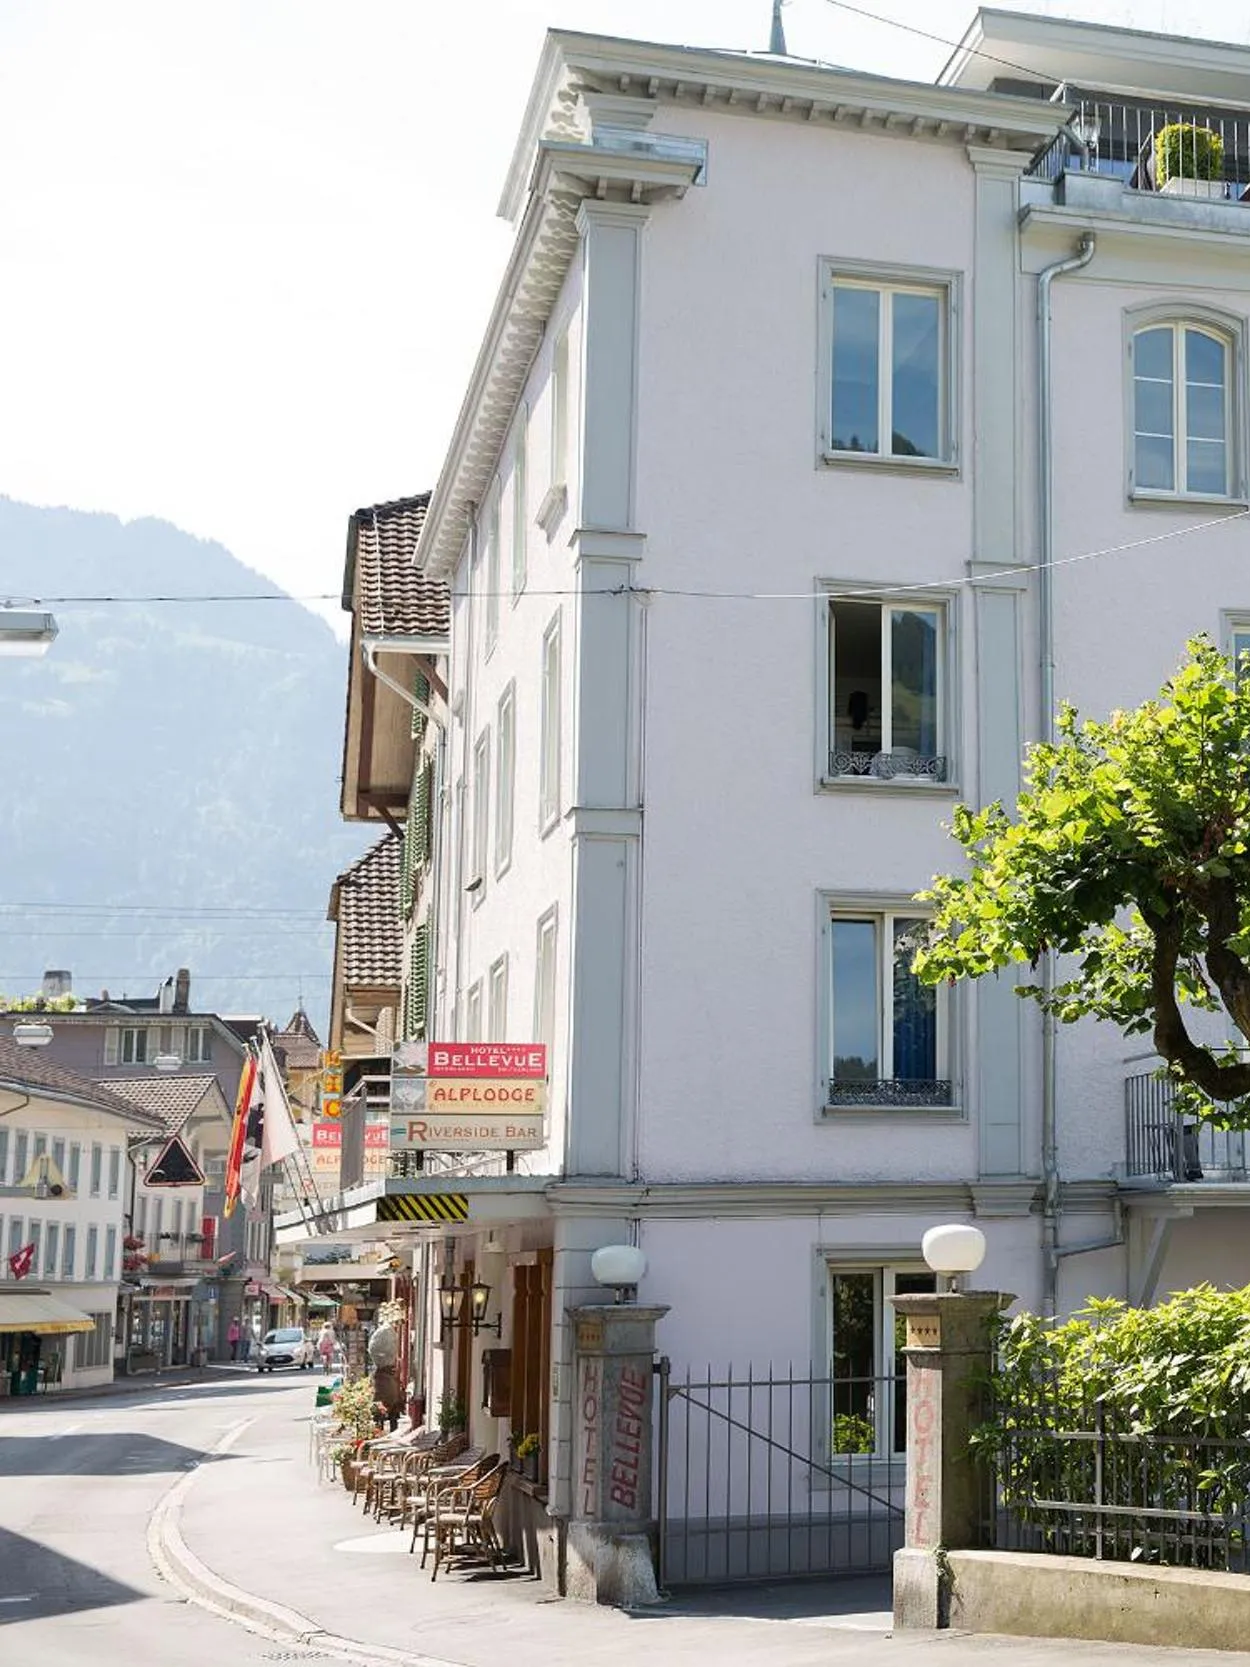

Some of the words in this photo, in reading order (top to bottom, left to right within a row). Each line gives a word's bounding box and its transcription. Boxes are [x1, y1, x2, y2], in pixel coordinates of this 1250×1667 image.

[434, 1051, 543, 1067] BELLEVUE
[471, 1047, 507, 1055] HOTEL
[434, 1087, 535, 1102] ALPLODGE
[407, 1121, 499, 1142] RIVERSIDE
[505, 1126, 538, 1138] BAR
[582, 1364, 599, 1515] HOTEL
[610, 1365, 648, 1510] BELLEVUE
[913, 1371, 935, 1545] HOTEL
